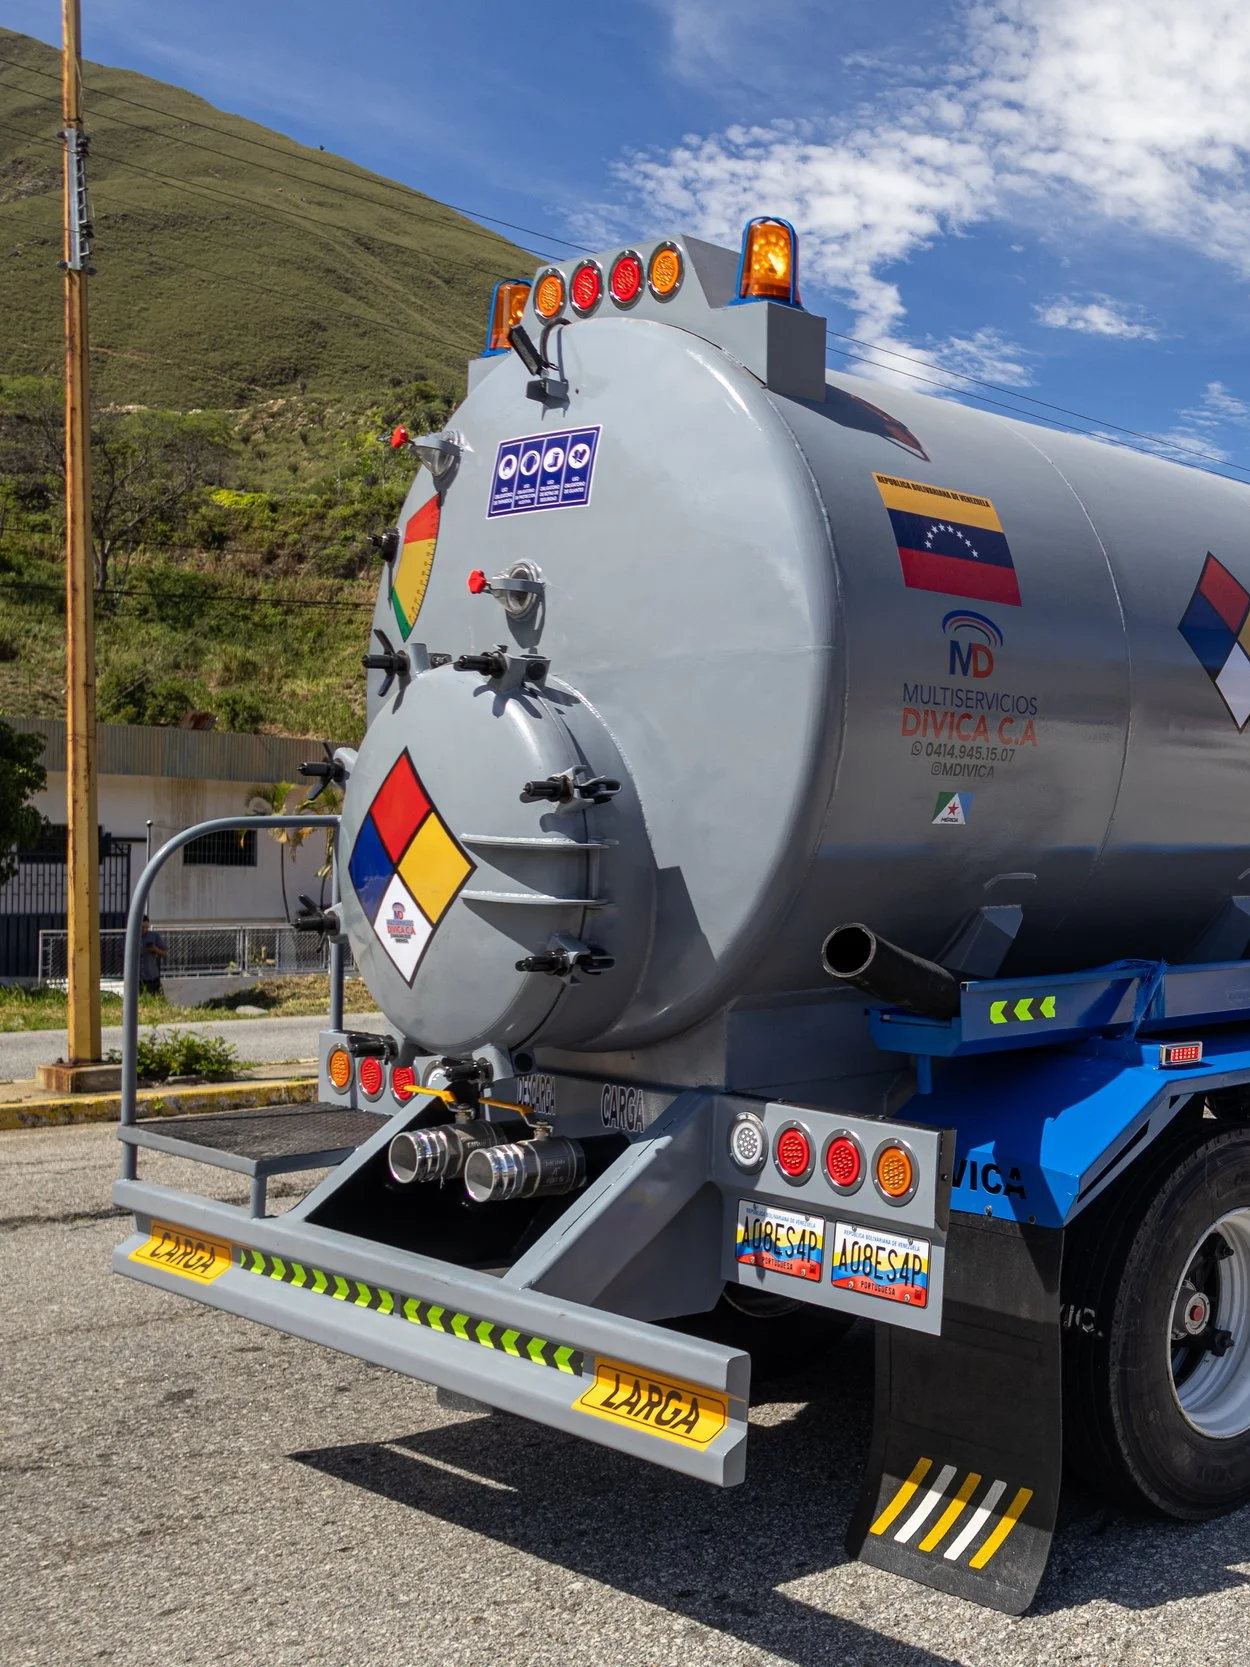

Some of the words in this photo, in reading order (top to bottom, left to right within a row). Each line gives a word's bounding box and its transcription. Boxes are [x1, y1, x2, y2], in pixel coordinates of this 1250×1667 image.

[911, 483, 952, 500] BOLIVARIANA
[951, 492, 960, 501] DE
[959, 494, 991, 508] VENEZUELA
[948, 640, 995, 679] MD
[902, 683, 1038, 716] MULTISERVICIOS
[901, 707, 991, 744] DIVICA
[997, 716, 1039, 748] C.A
[925, 742, 1016, 762] 0414.945.15.07
[516, 1074, 557, 1116] DESCARGA
[600, 1083, 646, 1134] CARGA
[150, 1232, 216, 1274] CARGA
[741, 1215, 818, 1263] A08ES4P
[865, 1234, 892, 1245] BOLIVARIANA
[897, 1241, 920, 1252] VENEZUELA
[761, 1256, 793, 1270] PORTUGUESA
[838, 1238, 922, 1288] A08ES4P
[860, 1280, 896, 1296] PORTUGUESA
[600, 1373, 701, 1435] LARGA
